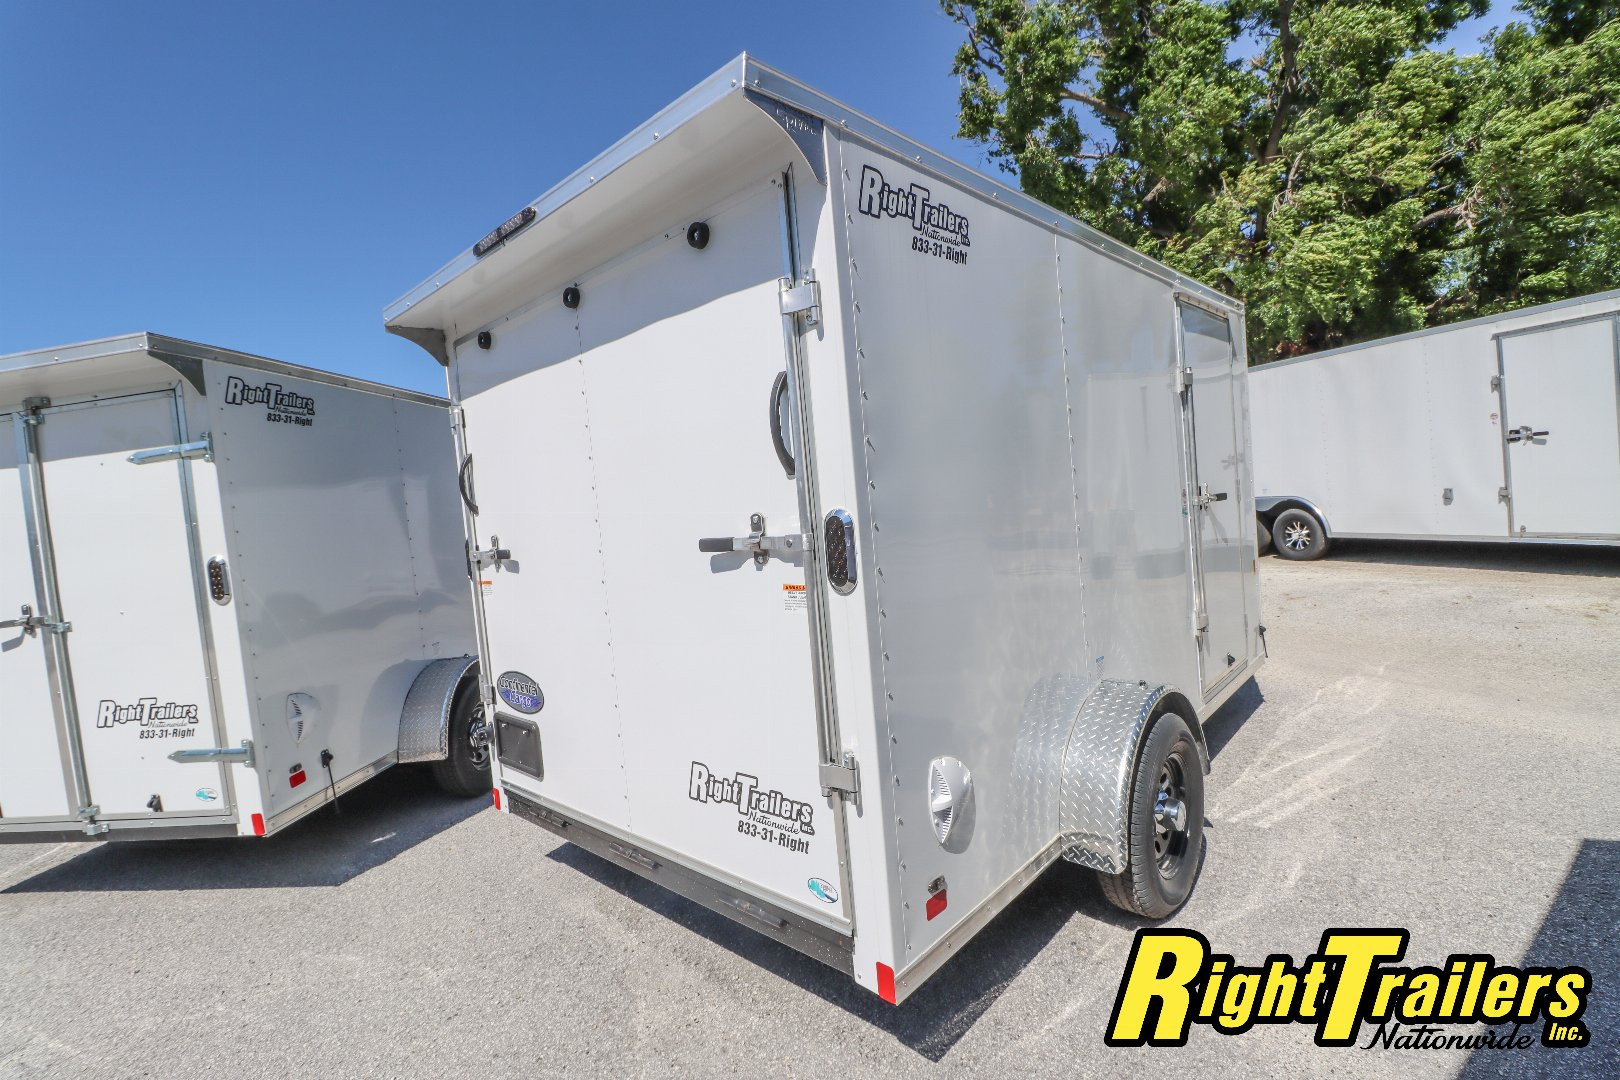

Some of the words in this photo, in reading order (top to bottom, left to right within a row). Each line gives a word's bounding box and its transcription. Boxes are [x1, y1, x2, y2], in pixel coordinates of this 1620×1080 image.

[911, 236, 968, 265] 833-31-Right
[266, 412, 313, 426] 833-31-Right
[139, 728, 195, 739] 833-31-Right
[747, 811, 800, 835] Nationwide
[737, 820, 810, 854] 833-31-Right
